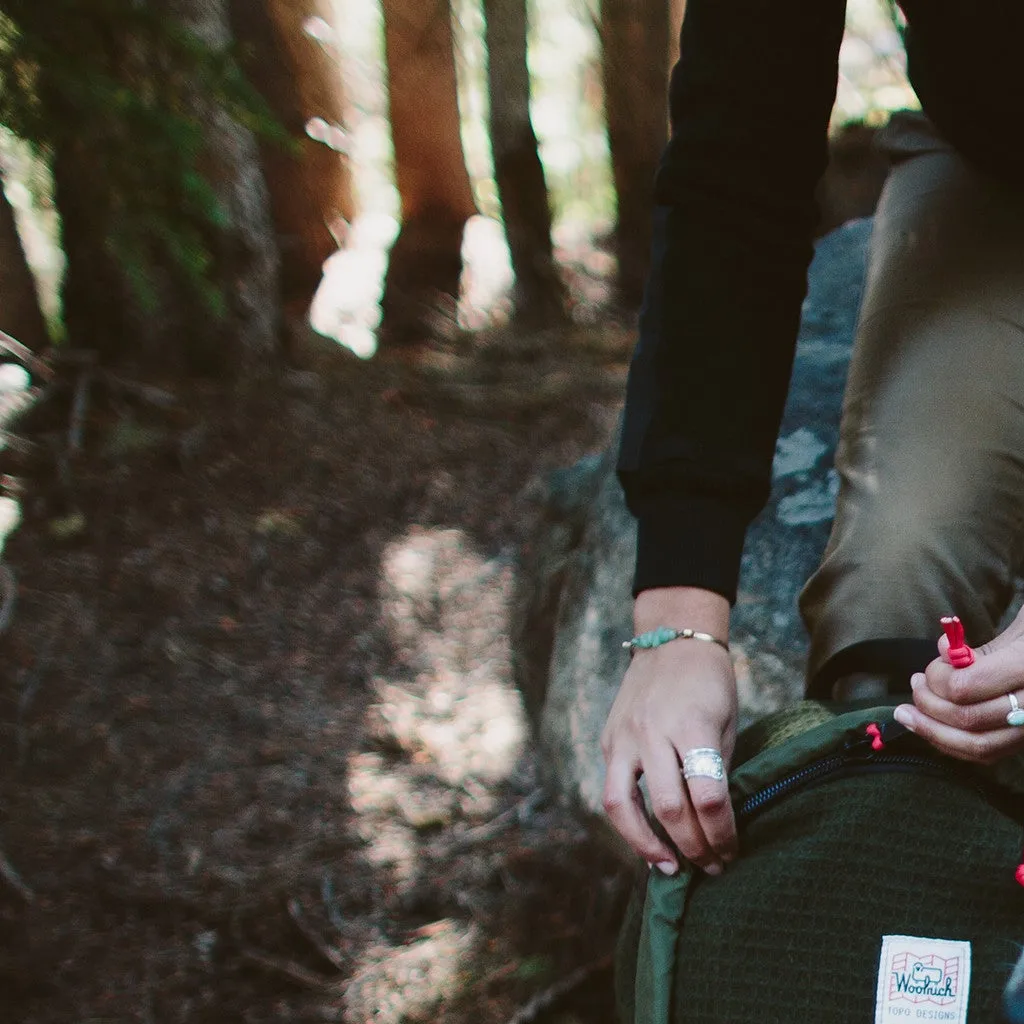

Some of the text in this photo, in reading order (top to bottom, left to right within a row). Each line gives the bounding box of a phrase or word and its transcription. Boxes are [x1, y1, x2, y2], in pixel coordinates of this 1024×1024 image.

[892, 972, 955, 997] Woolrich
[888, 1006, 956, 1020] TOPO DESIGNS
